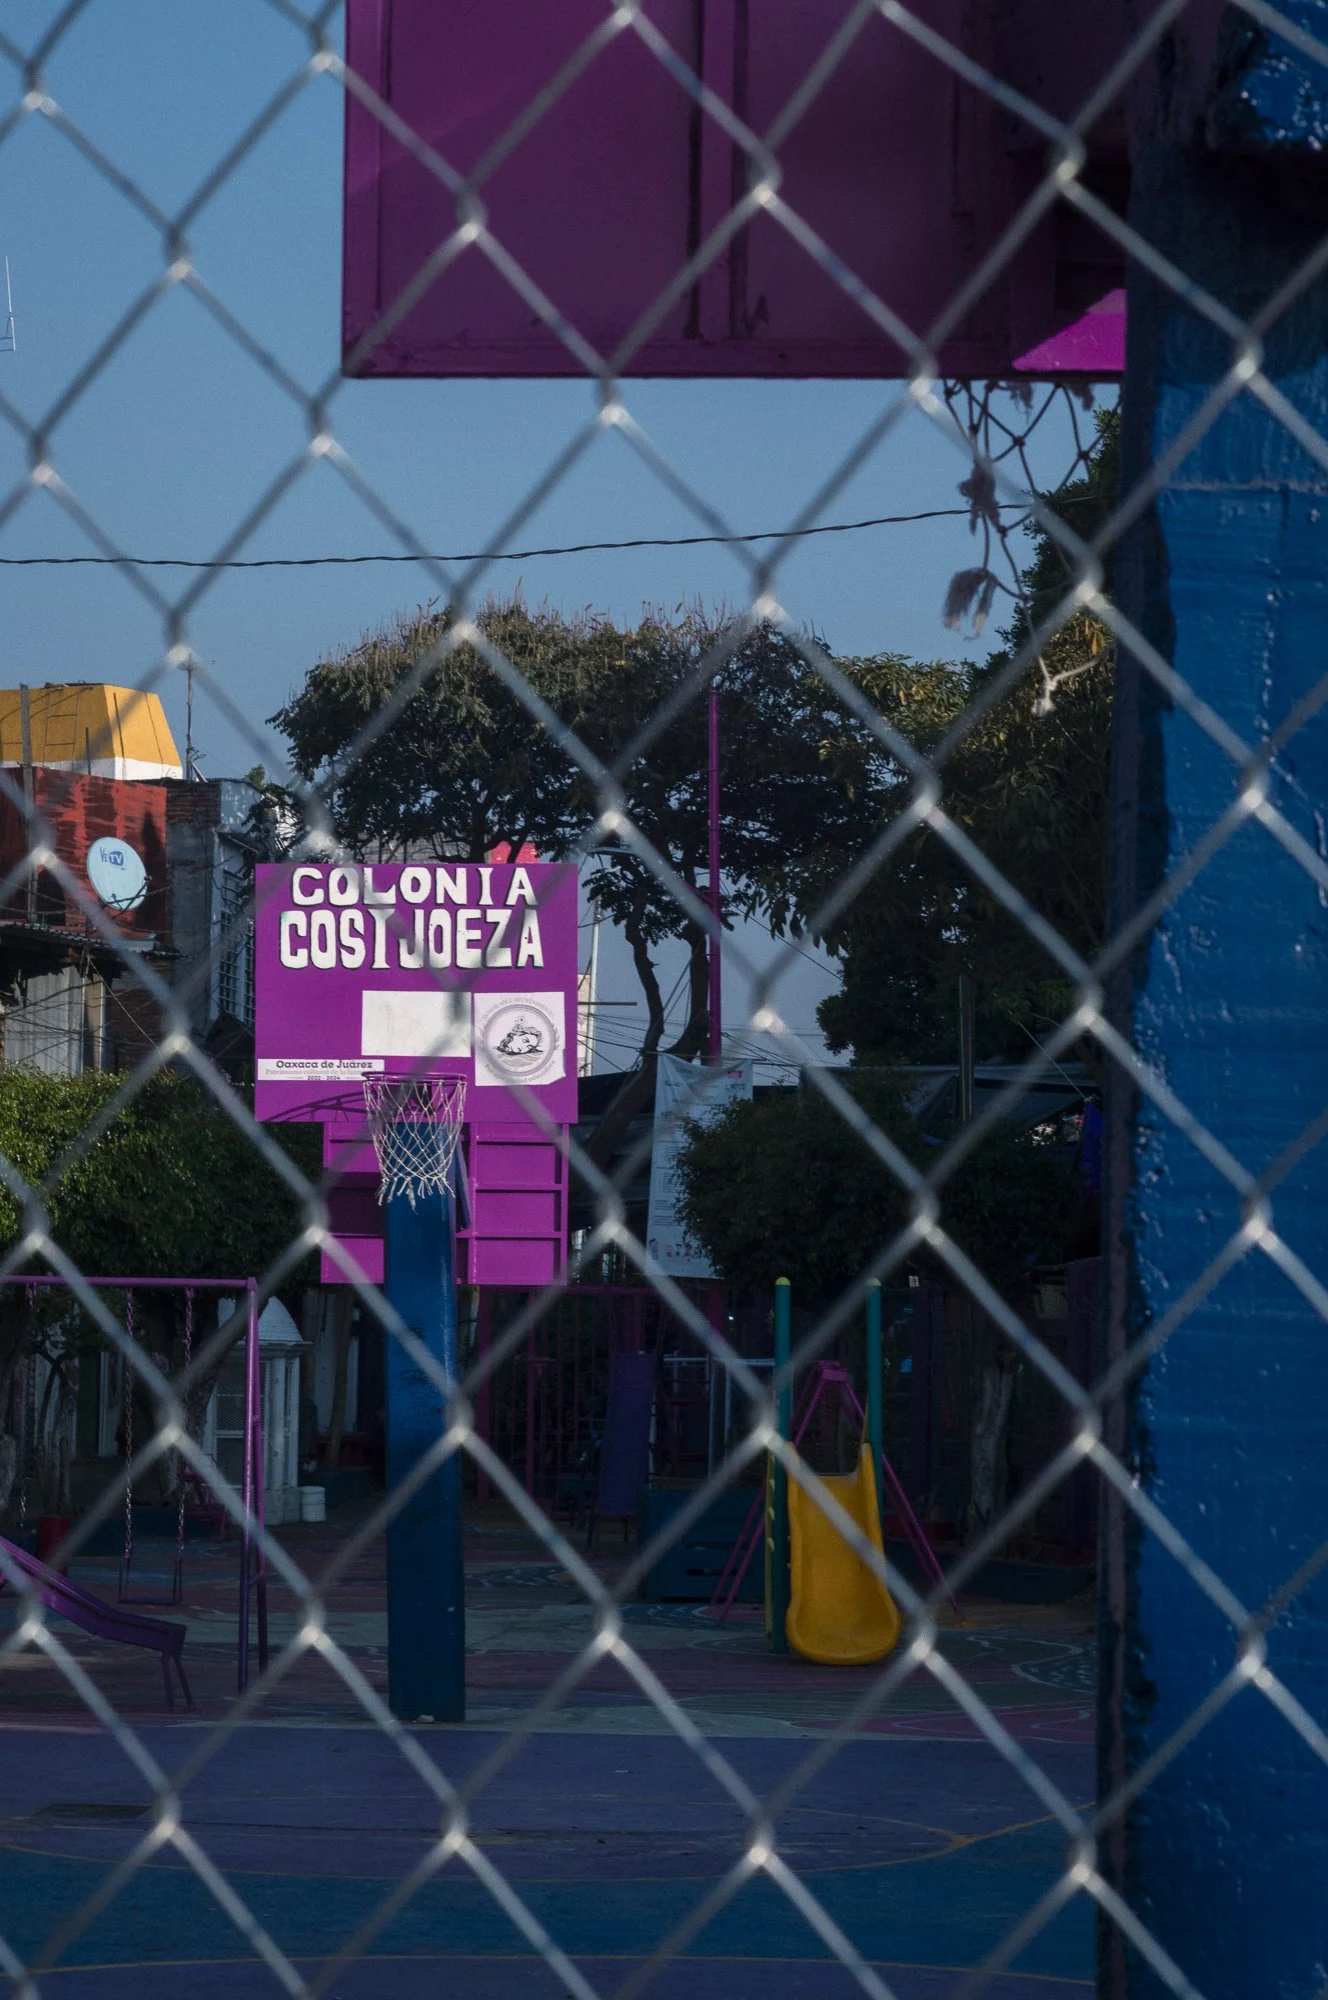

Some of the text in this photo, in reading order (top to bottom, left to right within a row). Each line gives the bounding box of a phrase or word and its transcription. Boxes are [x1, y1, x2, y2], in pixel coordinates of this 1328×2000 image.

[291, 866, 539, 906] COLONIA
[279, 908, 545, 969] COSIJOEZA
[276, 1059, 373, 1069] Oaxaca de Juárez
